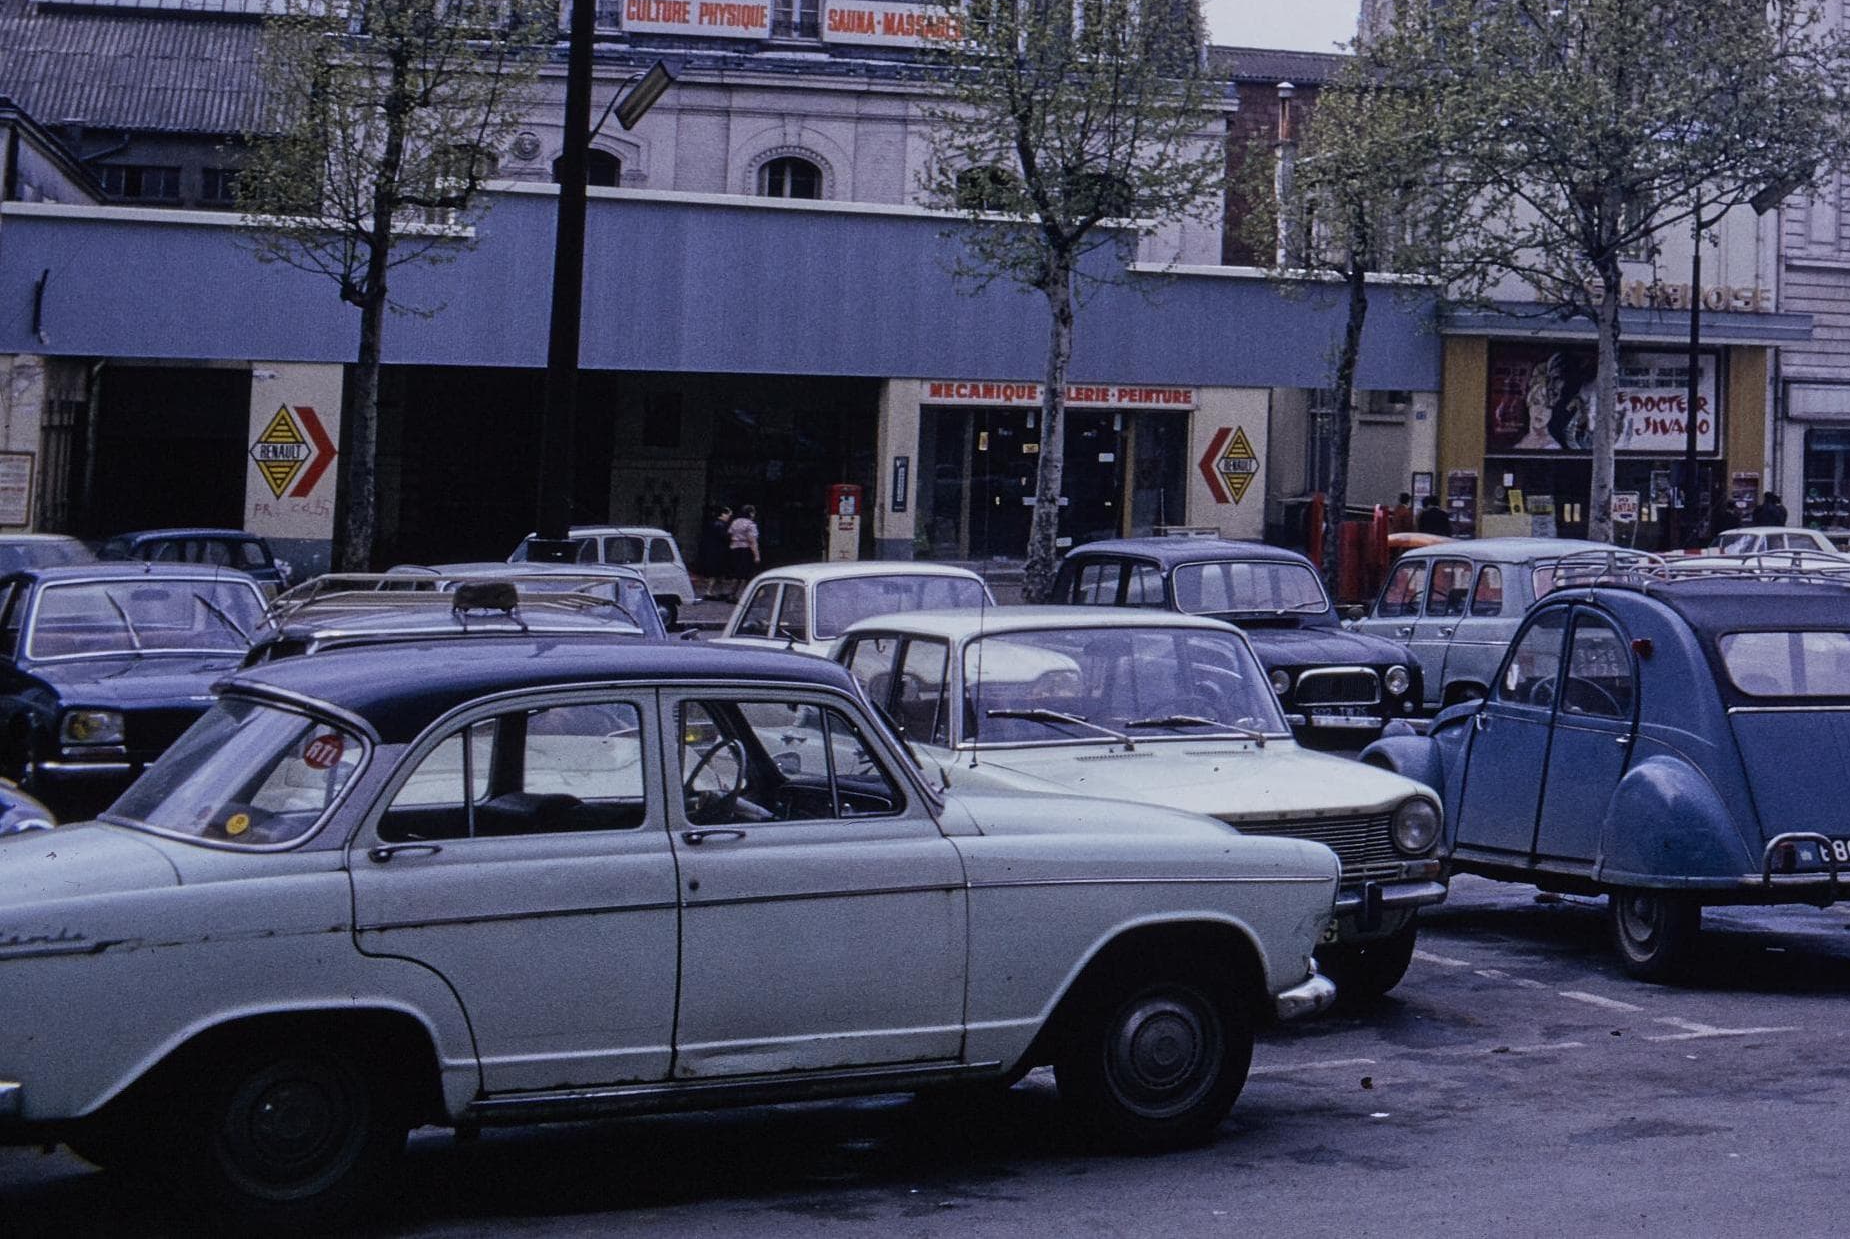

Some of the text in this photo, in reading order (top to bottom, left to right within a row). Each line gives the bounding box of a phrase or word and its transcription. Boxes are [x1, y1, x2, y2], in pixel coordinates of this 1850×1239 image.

[698, 1, 769, 31] PHYSIQUE
[827, 8, 877, 35] SAUNA
[929, 382, 1193, 404] MECANIQUE LERIE PEINTURE
[1629, 394, 1710, 415] DOCTER
[259, 444, 301, 459] RENAULT
[306, 740, 338, 767] RTL
